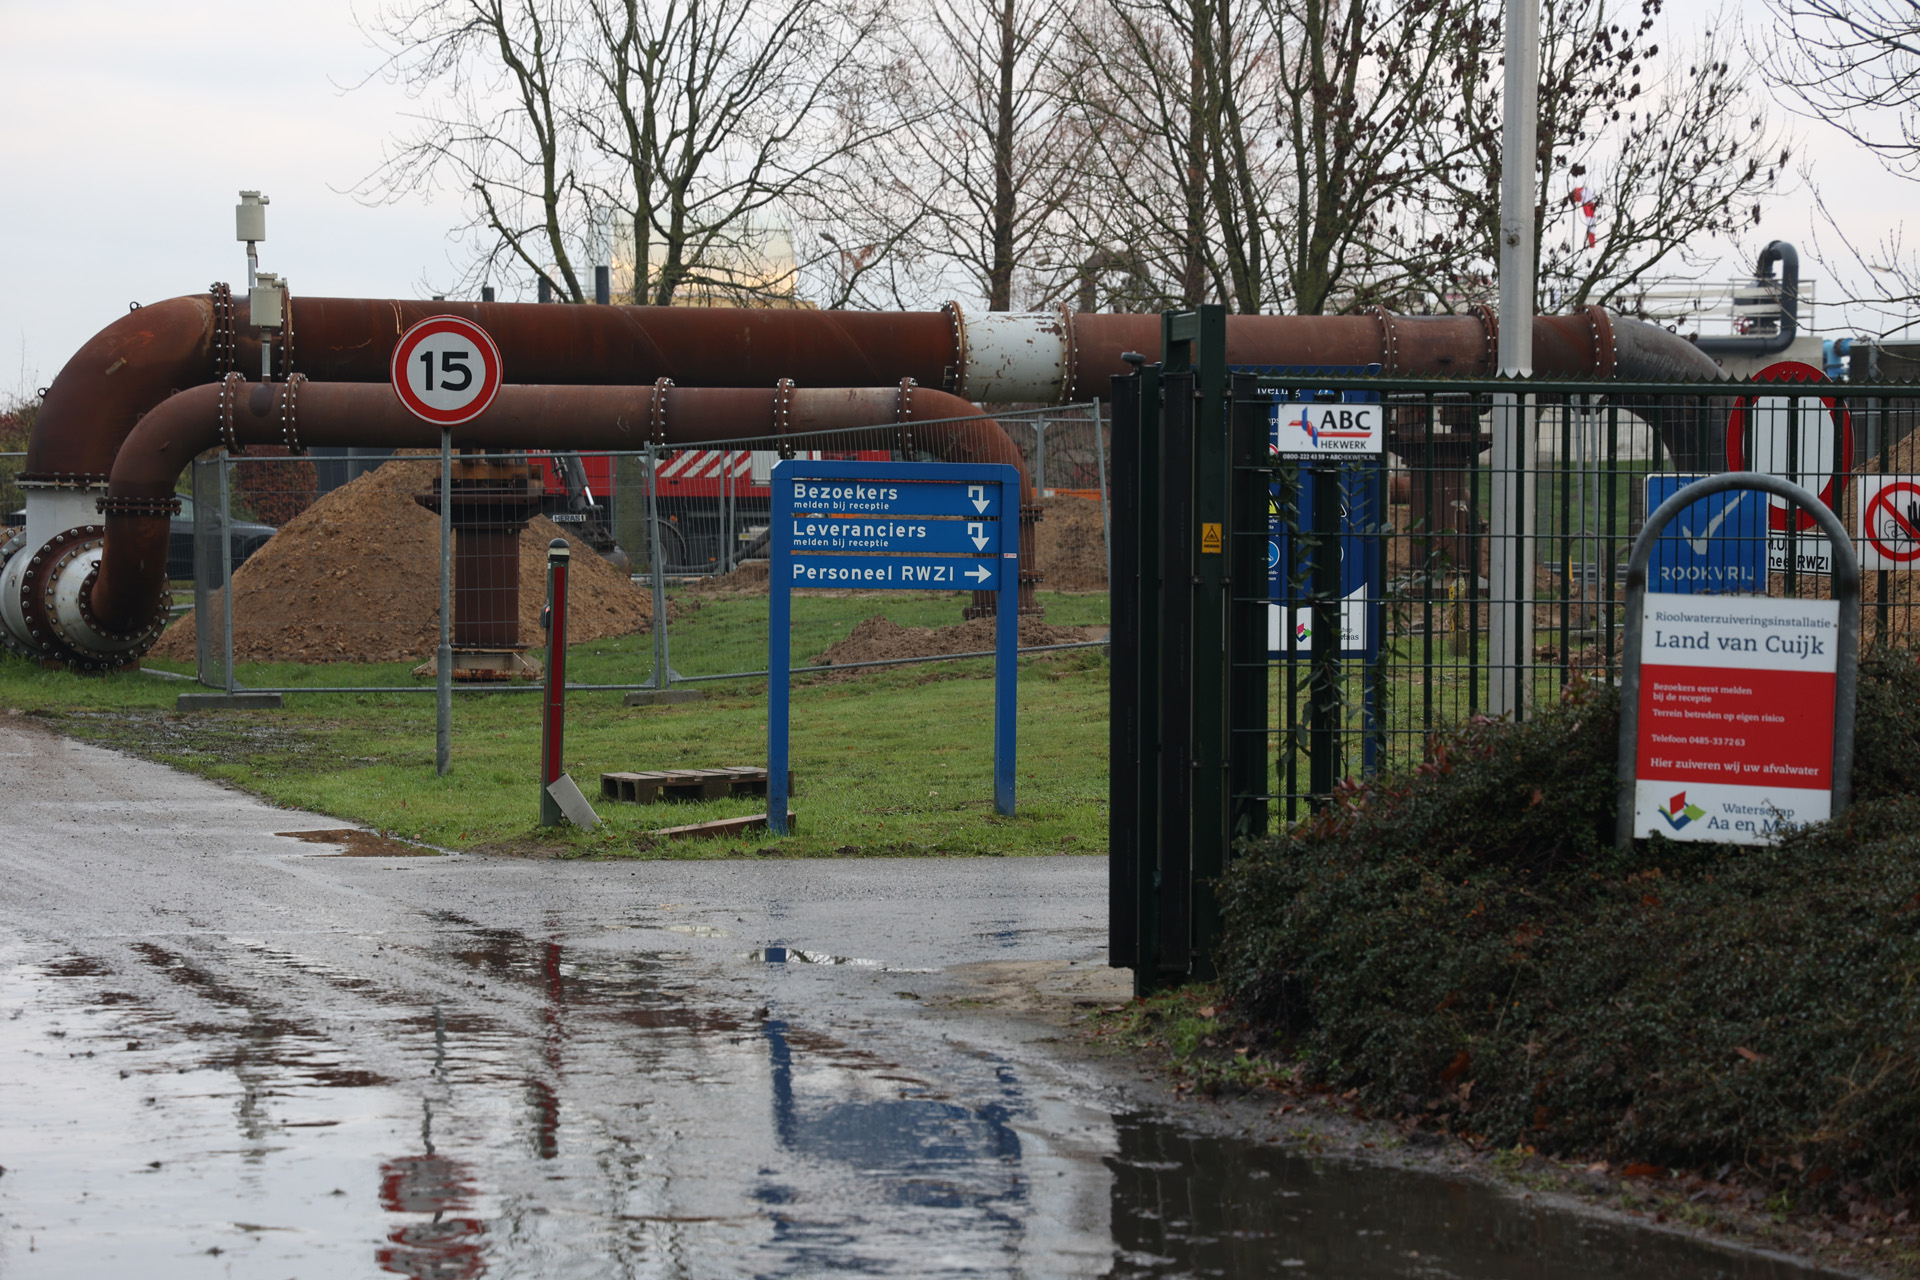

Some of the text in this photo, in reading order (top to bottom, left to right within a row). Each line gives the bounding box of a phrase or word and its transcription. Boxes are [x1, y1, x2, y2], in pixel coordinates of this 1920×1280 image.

[420, 351, 472, 391] 15
[1320, 410, 1371, 430] ABC
[1320, 440, 1367, 449] HEKWERK
[794, 483, 898, 500] Bezoekers
[794, 500, 890, 511] melden bij receptie
[793, 520, 927, 538] Leveranciers
[793, 538, 889, 548] melden bij receptie
[1797, 555, 1829, 570] RWZI
[793, 564, 954, 582] Personeel RWZI
[1660, 566, 1755, 581] ROOKVRIJ
[1655, 611, 1831, 628] Rioolwaterzuiveringsinstallatie
[1655, 630, 1824, 659] Land van Cuijk
[1653, 682, 1752, 695] Bezoekers eerst melden
[1653, 692, 1712, 704] bij de receptie
[1652, 708, 1785, 723] Terrein betreden op eigen risico
[1651, 734, 1688, 744] Telefoon
[1650, 758, 1819, 776] Hier zuiveren wij uw afvalwater
[1707, 816, 1730, 830] Aa
[1735, 820, 1756, 832] en
